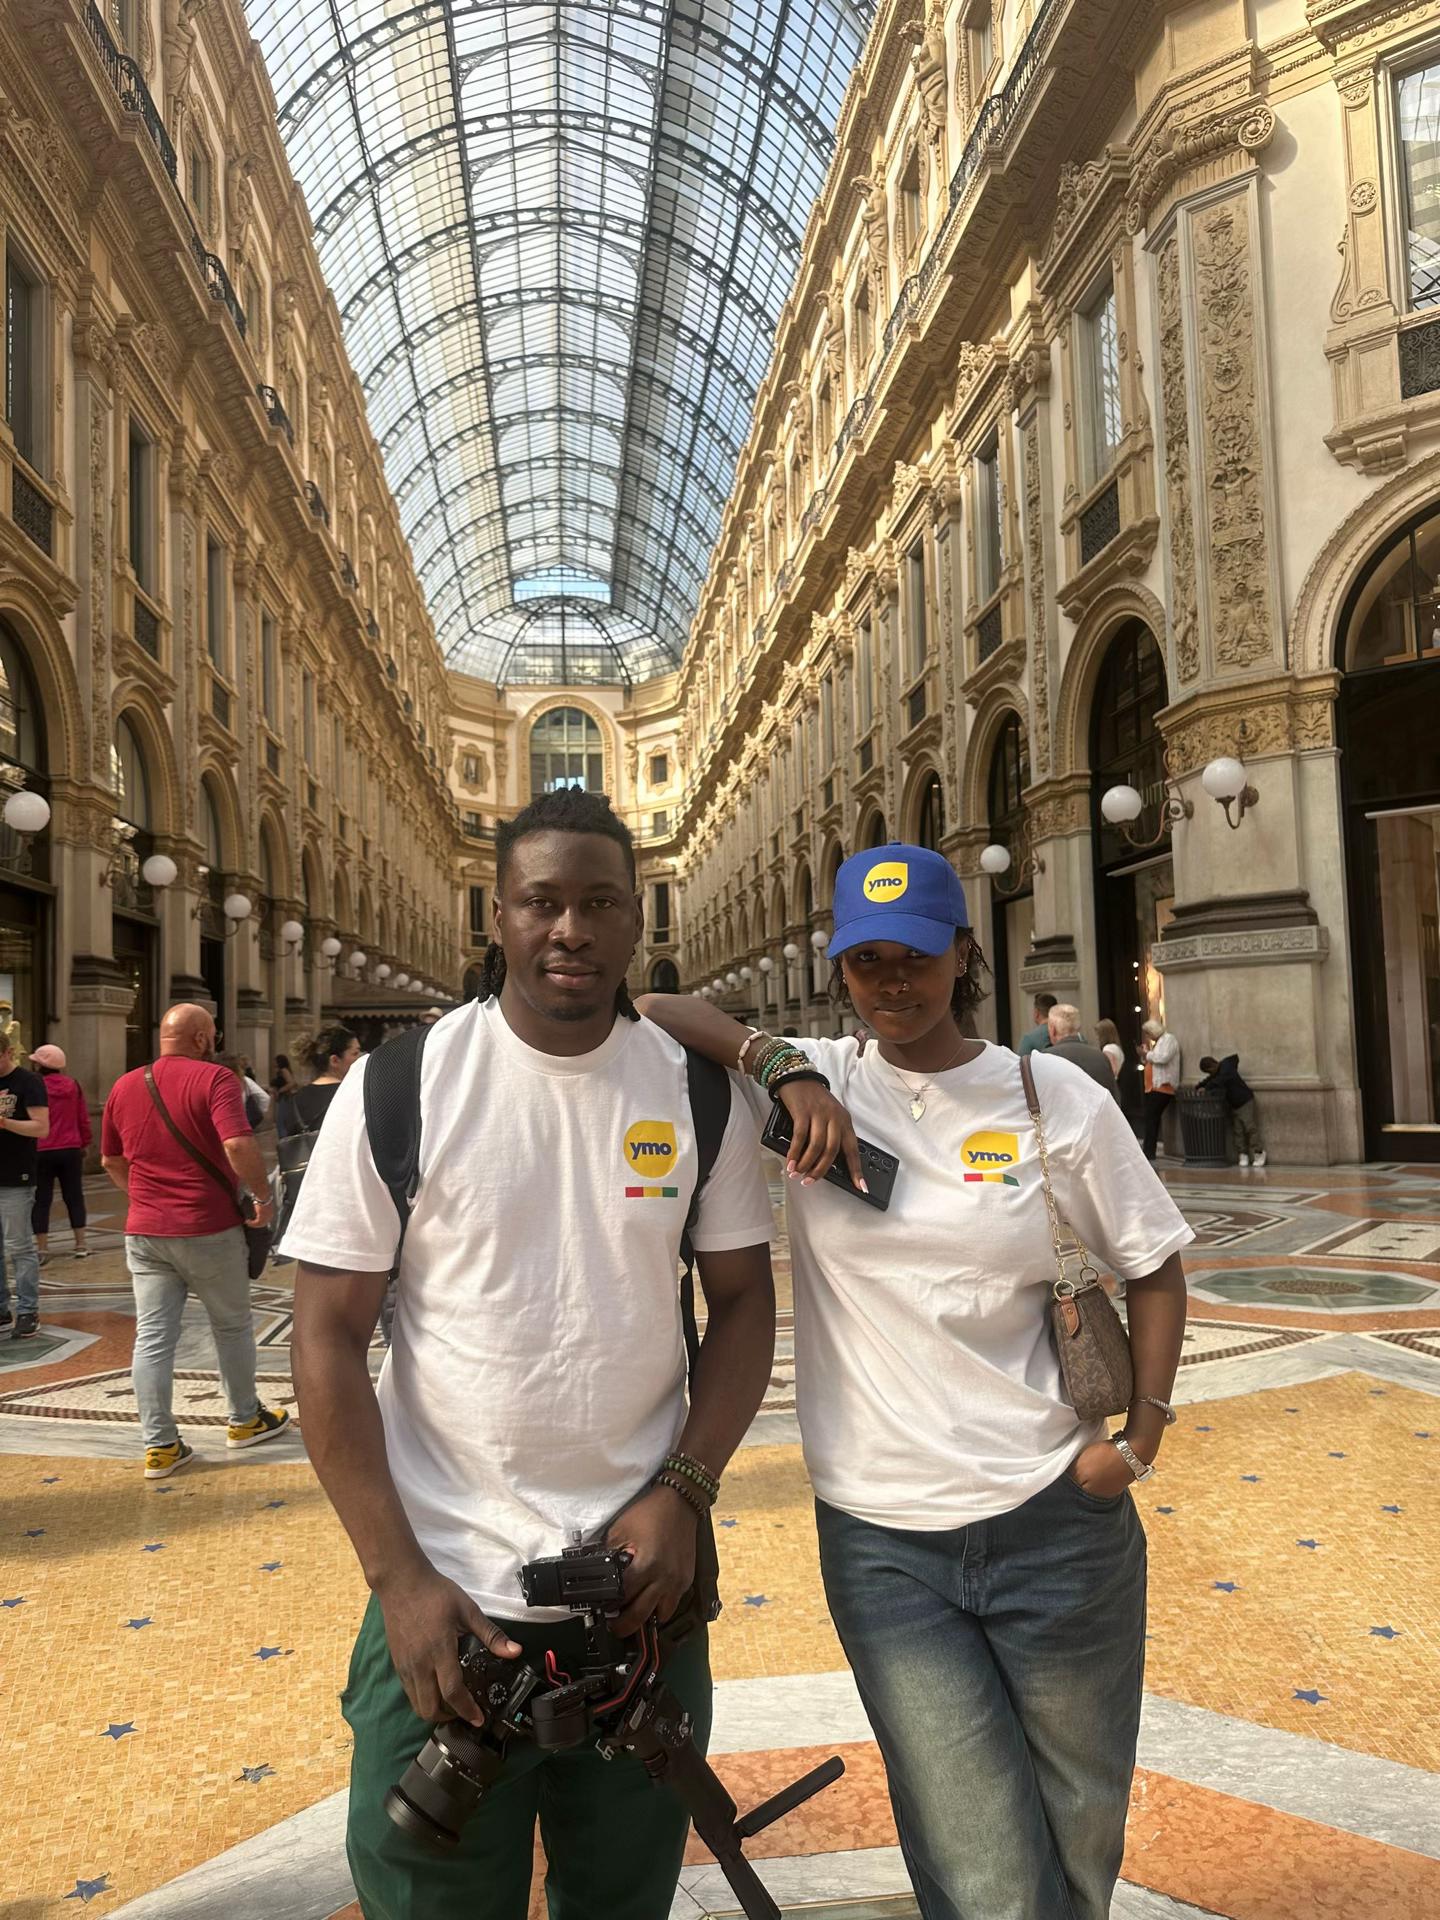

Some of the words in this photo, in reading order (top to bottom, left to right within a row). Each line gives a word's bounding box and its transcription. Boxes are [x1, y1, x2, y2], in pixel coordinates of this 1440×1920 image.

[868, 878, 903, 893] ymo
[630, 1142, 672, 1160] ymo
[967, 1150, 1013, 1164] ymo
